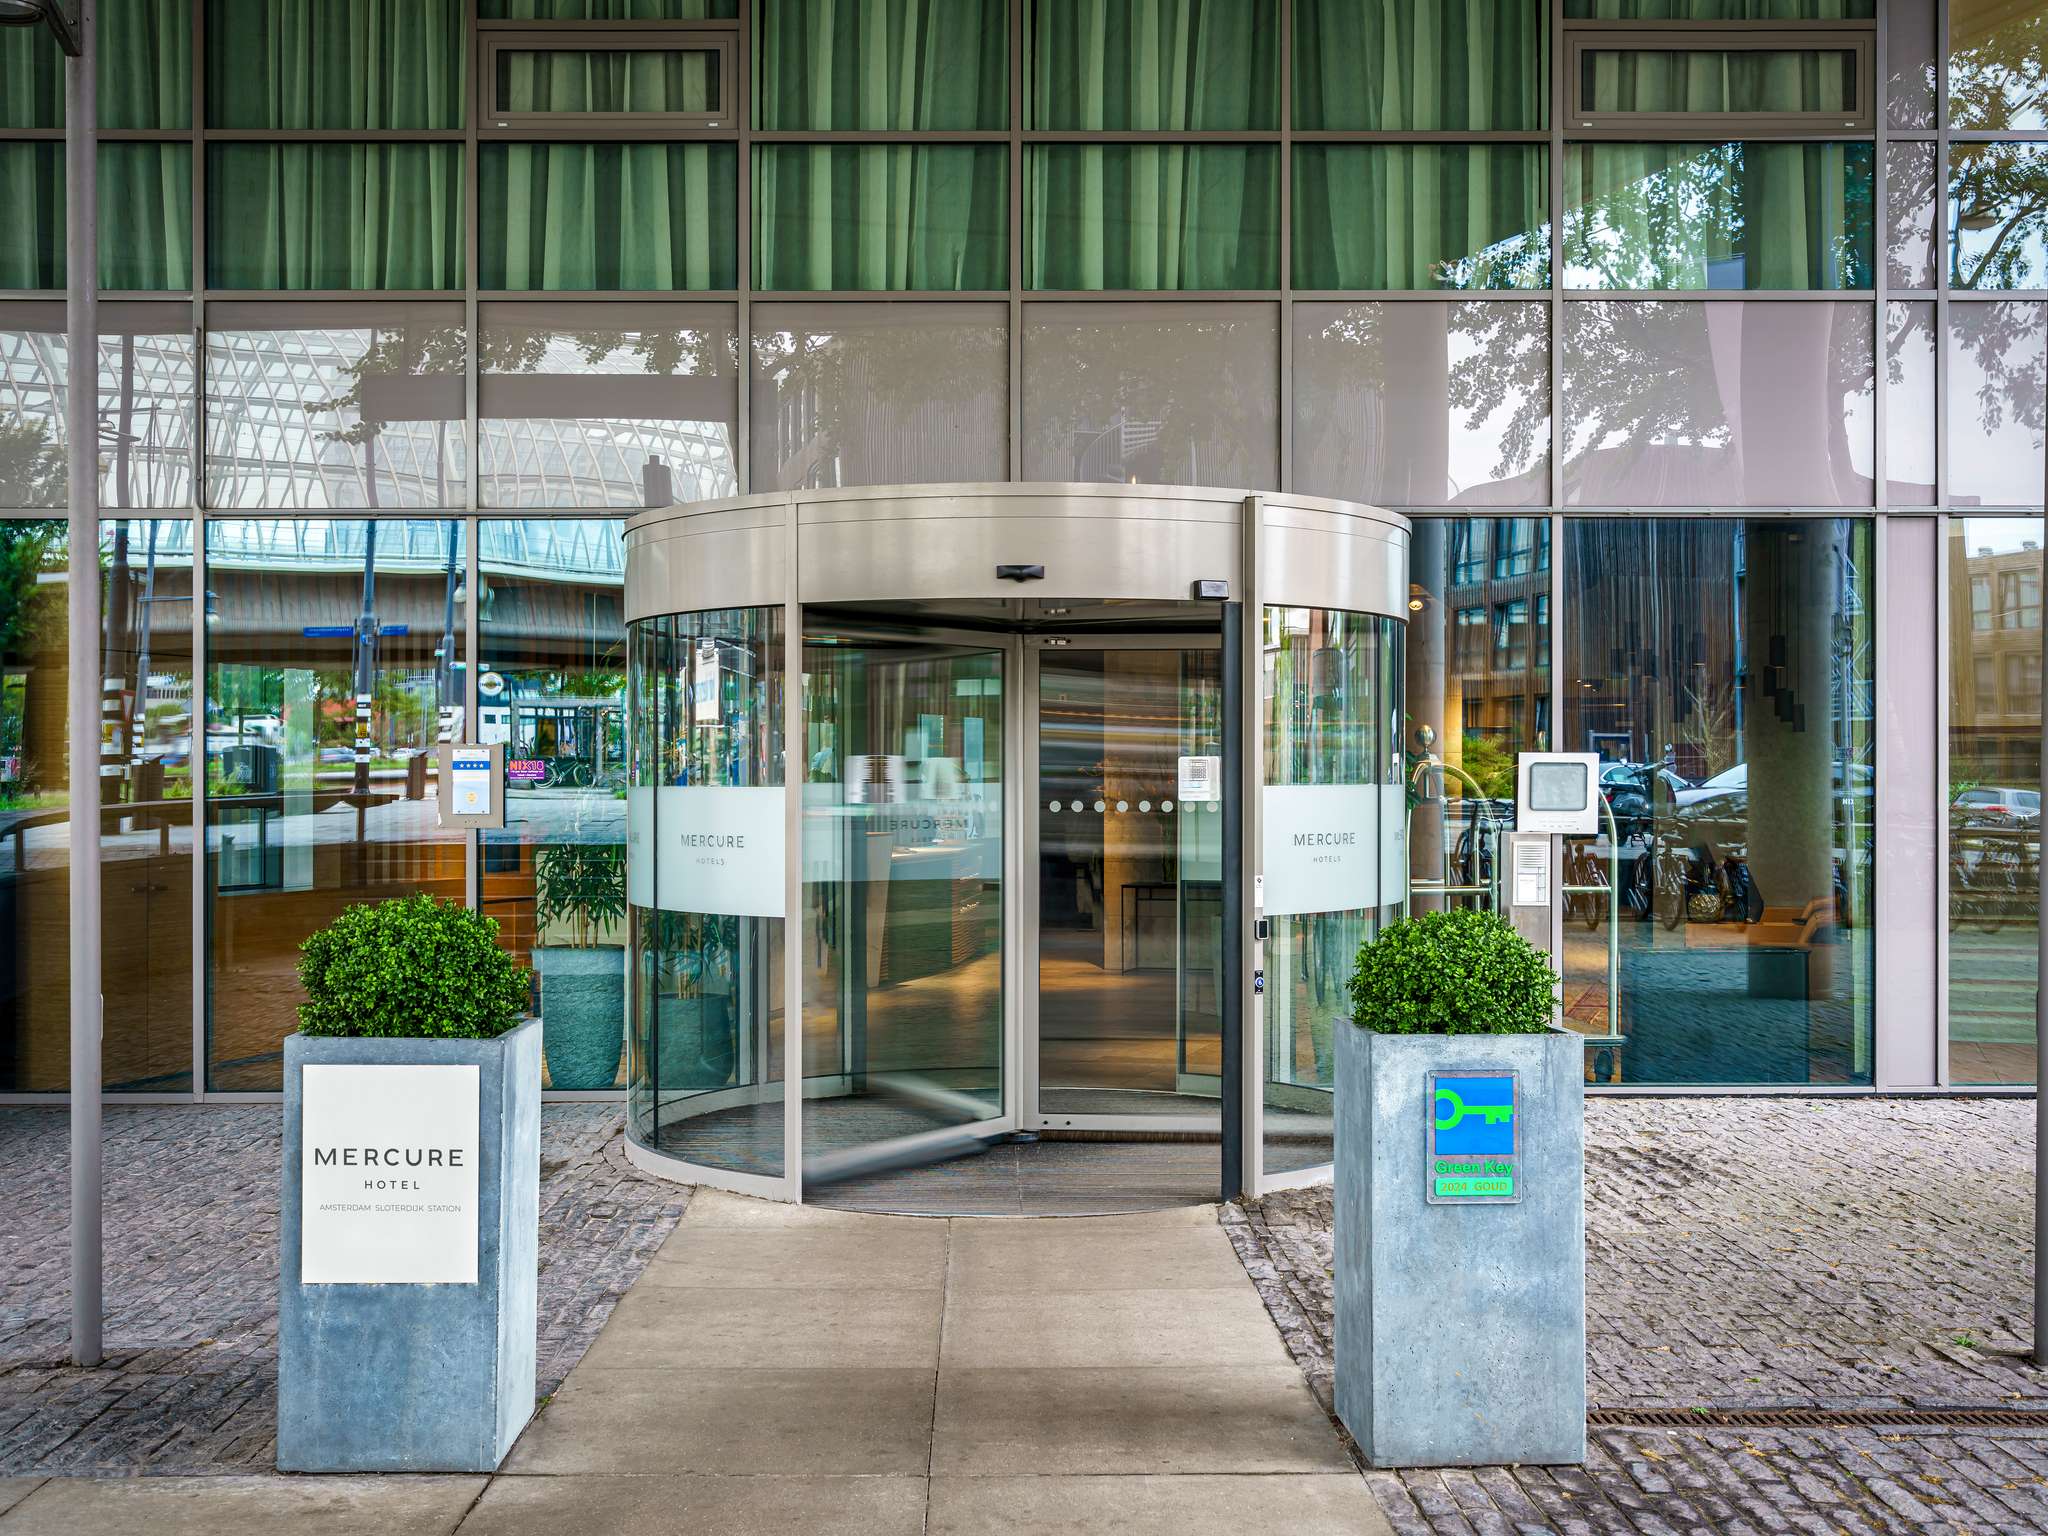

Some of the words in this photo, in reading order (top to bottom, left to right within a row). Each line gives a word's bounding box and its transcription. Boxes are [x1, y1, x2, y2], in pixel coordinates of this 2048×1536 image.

[510, 760, 545, 770] NIX18
[680, 834, 745, 848] MERCURE
[1294, 832, 1356, 846] MERCURE
[696, 857, 725, 865] HOTELS
[314, 1148, 464, 1167] MERCURE
[1434, 1160, 1481, 1174] Green
[1485, 1160, 1513, 1176] Key
[364, 1180, 420, 1190] HOTEL
[1441, 1182, 1467, 1191] 2024
[1474, 1181, 1508, 1191] GOUD
[319, 1204, 371, 1212] AMSTERDAM
[375, 1204, 424, 1212] SLOTERDIJK
[427, 1204, 462, 1213] STATION
